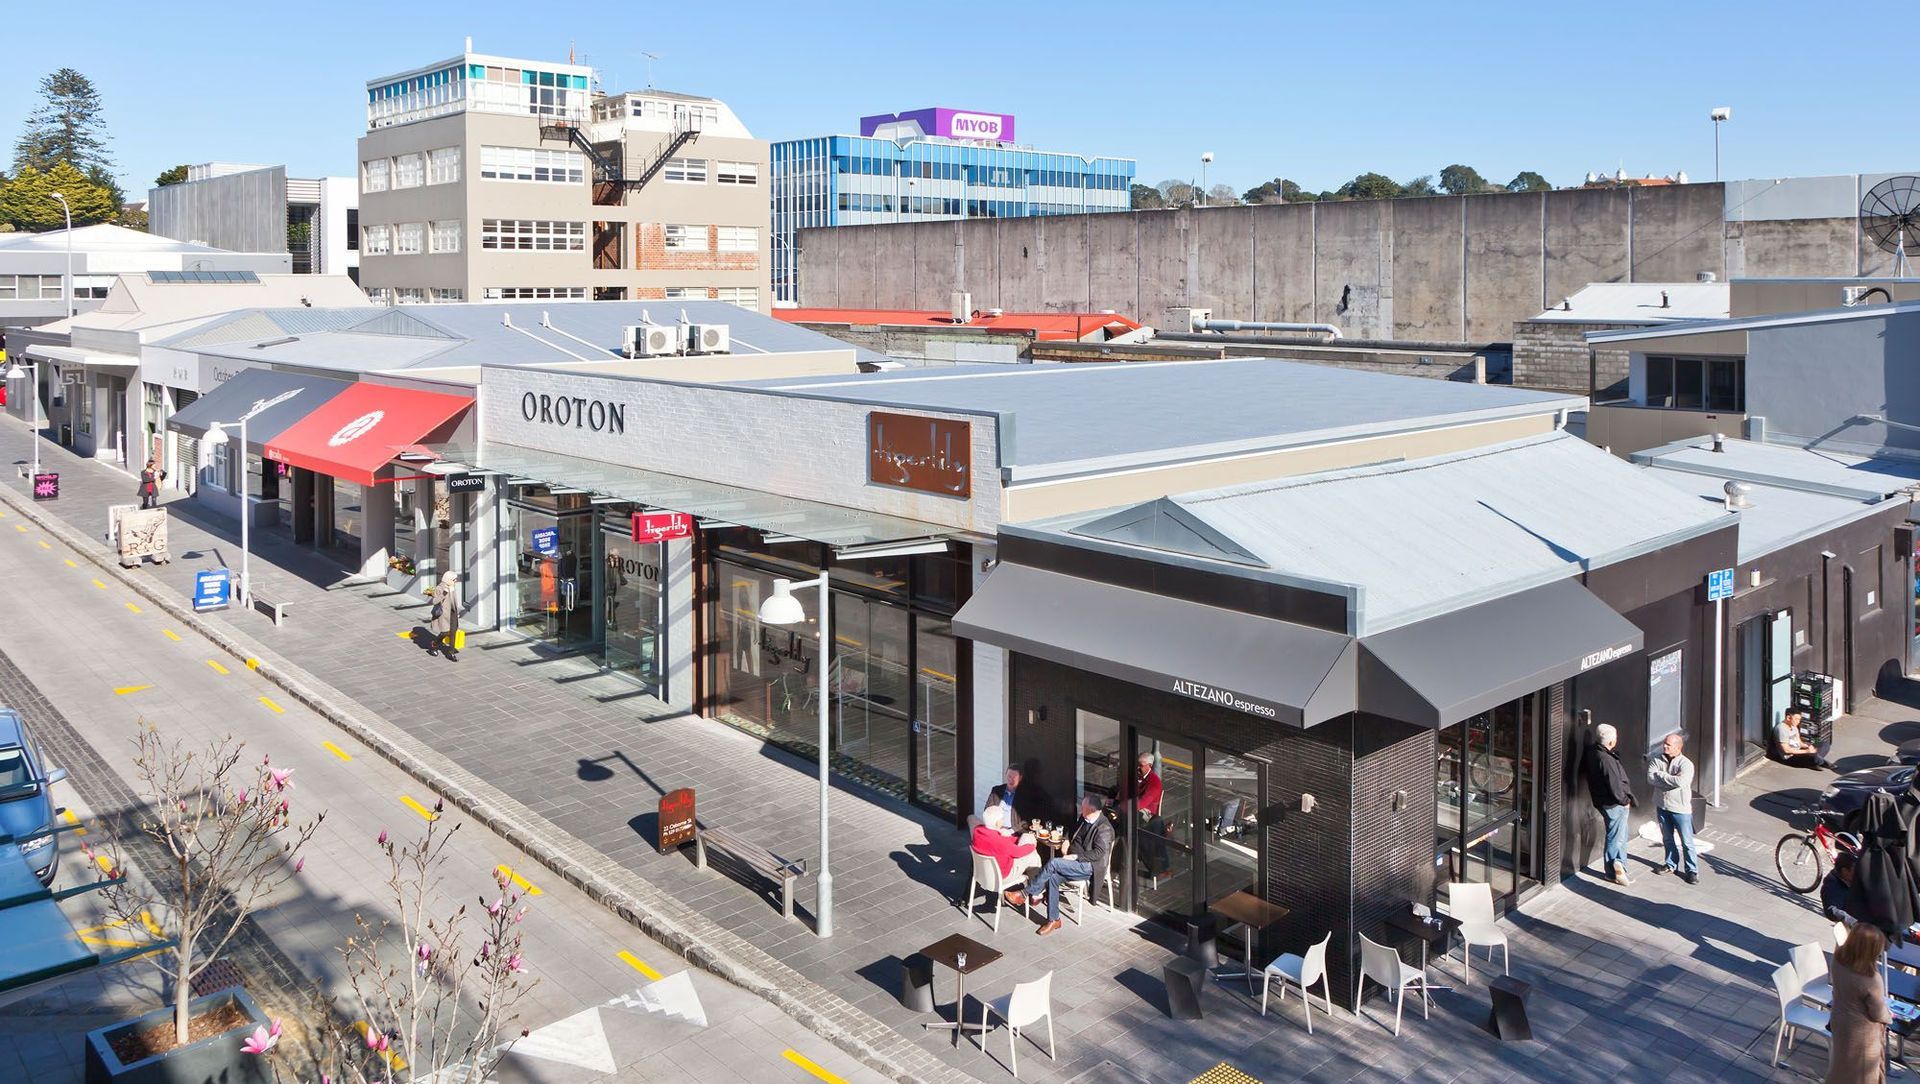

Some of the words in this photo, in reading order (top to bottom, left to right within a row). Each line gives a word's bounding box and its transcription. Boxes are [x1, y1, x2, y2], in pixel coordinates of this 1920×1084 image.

[955, 118, 999, 134] MYOB
[521, 391, 626, 435] OROTON
[872, 422, 968, 492] tigerlily
[451, 477, 483, 488] OROTON
[645, 514, 688, 540] tigerlily
[1580, 647, 1613, 671] ALTEZANO
[1613, 643, 1633, 659] espresso
[1173, 679, 1233, 706] ALTEZANO
[1234, 699, 1275, 717] espresso
